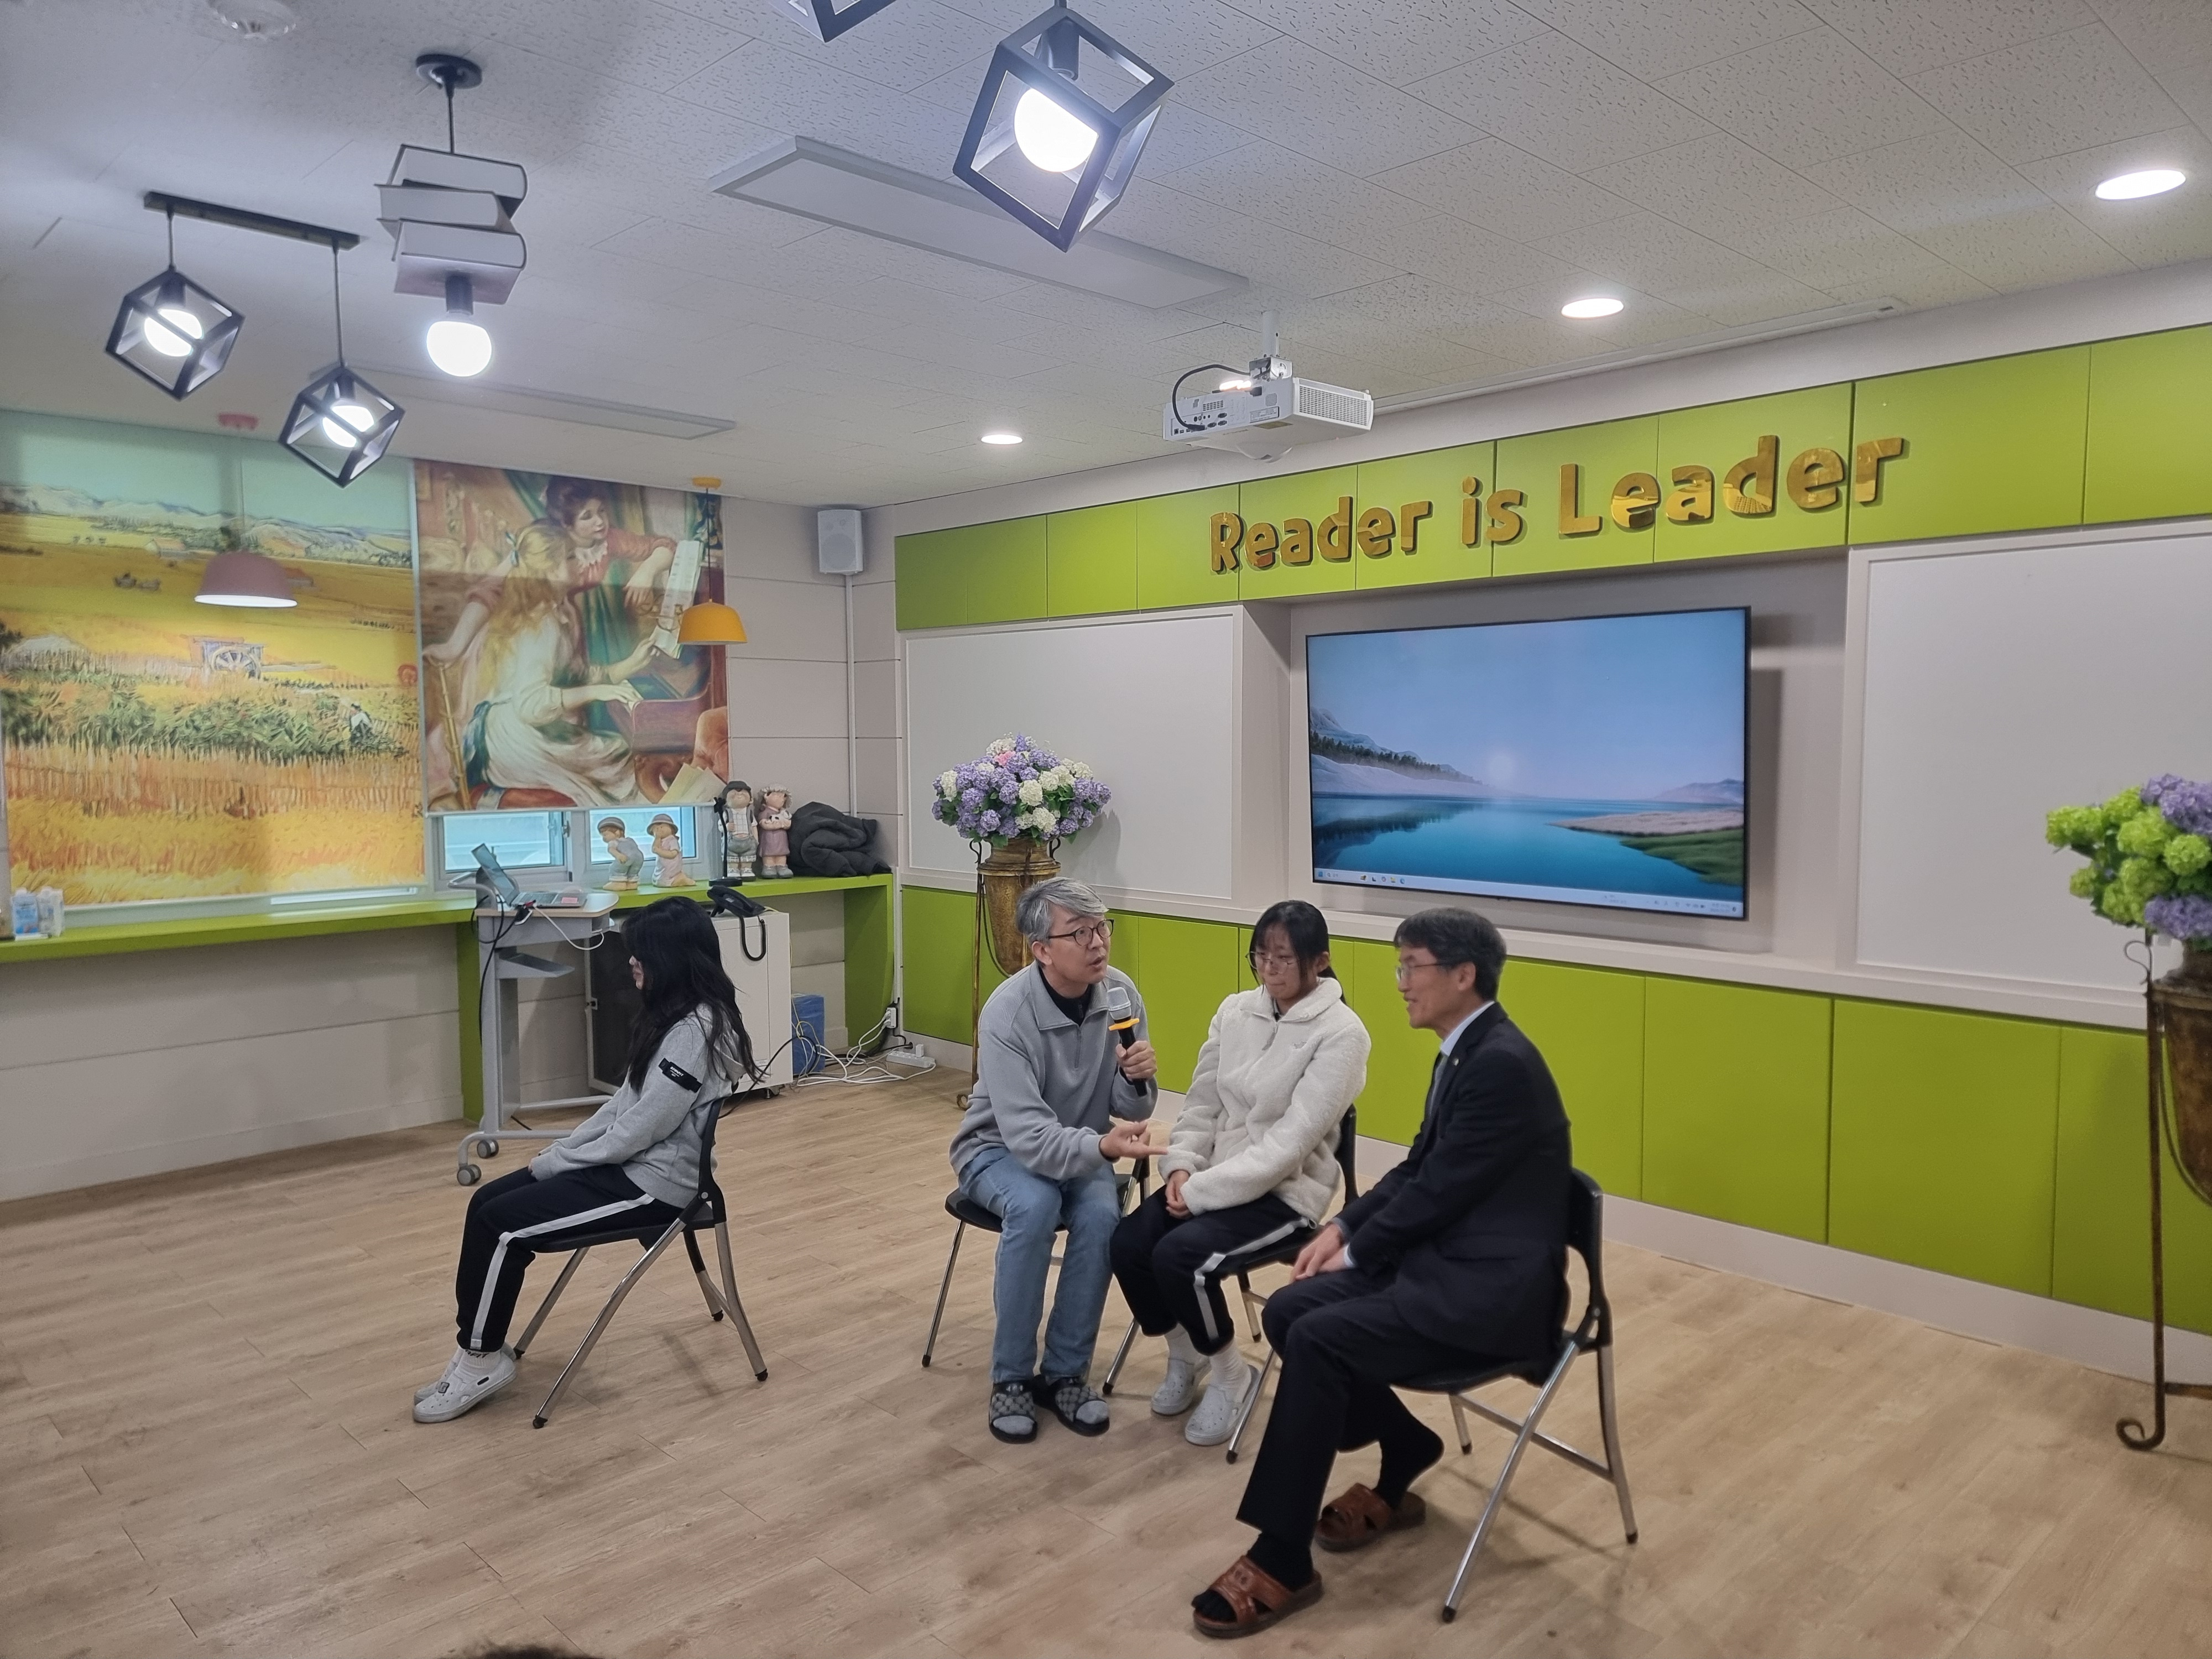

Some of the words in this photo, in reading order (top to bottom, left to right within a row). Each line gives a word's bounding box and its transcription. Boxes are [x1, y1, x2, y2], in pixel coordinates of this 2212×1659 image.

[1209, 495, 1433, 573] Reader
[1462, 476, 1525, 545] is
[1559, 435, 1904, 535] Leader
